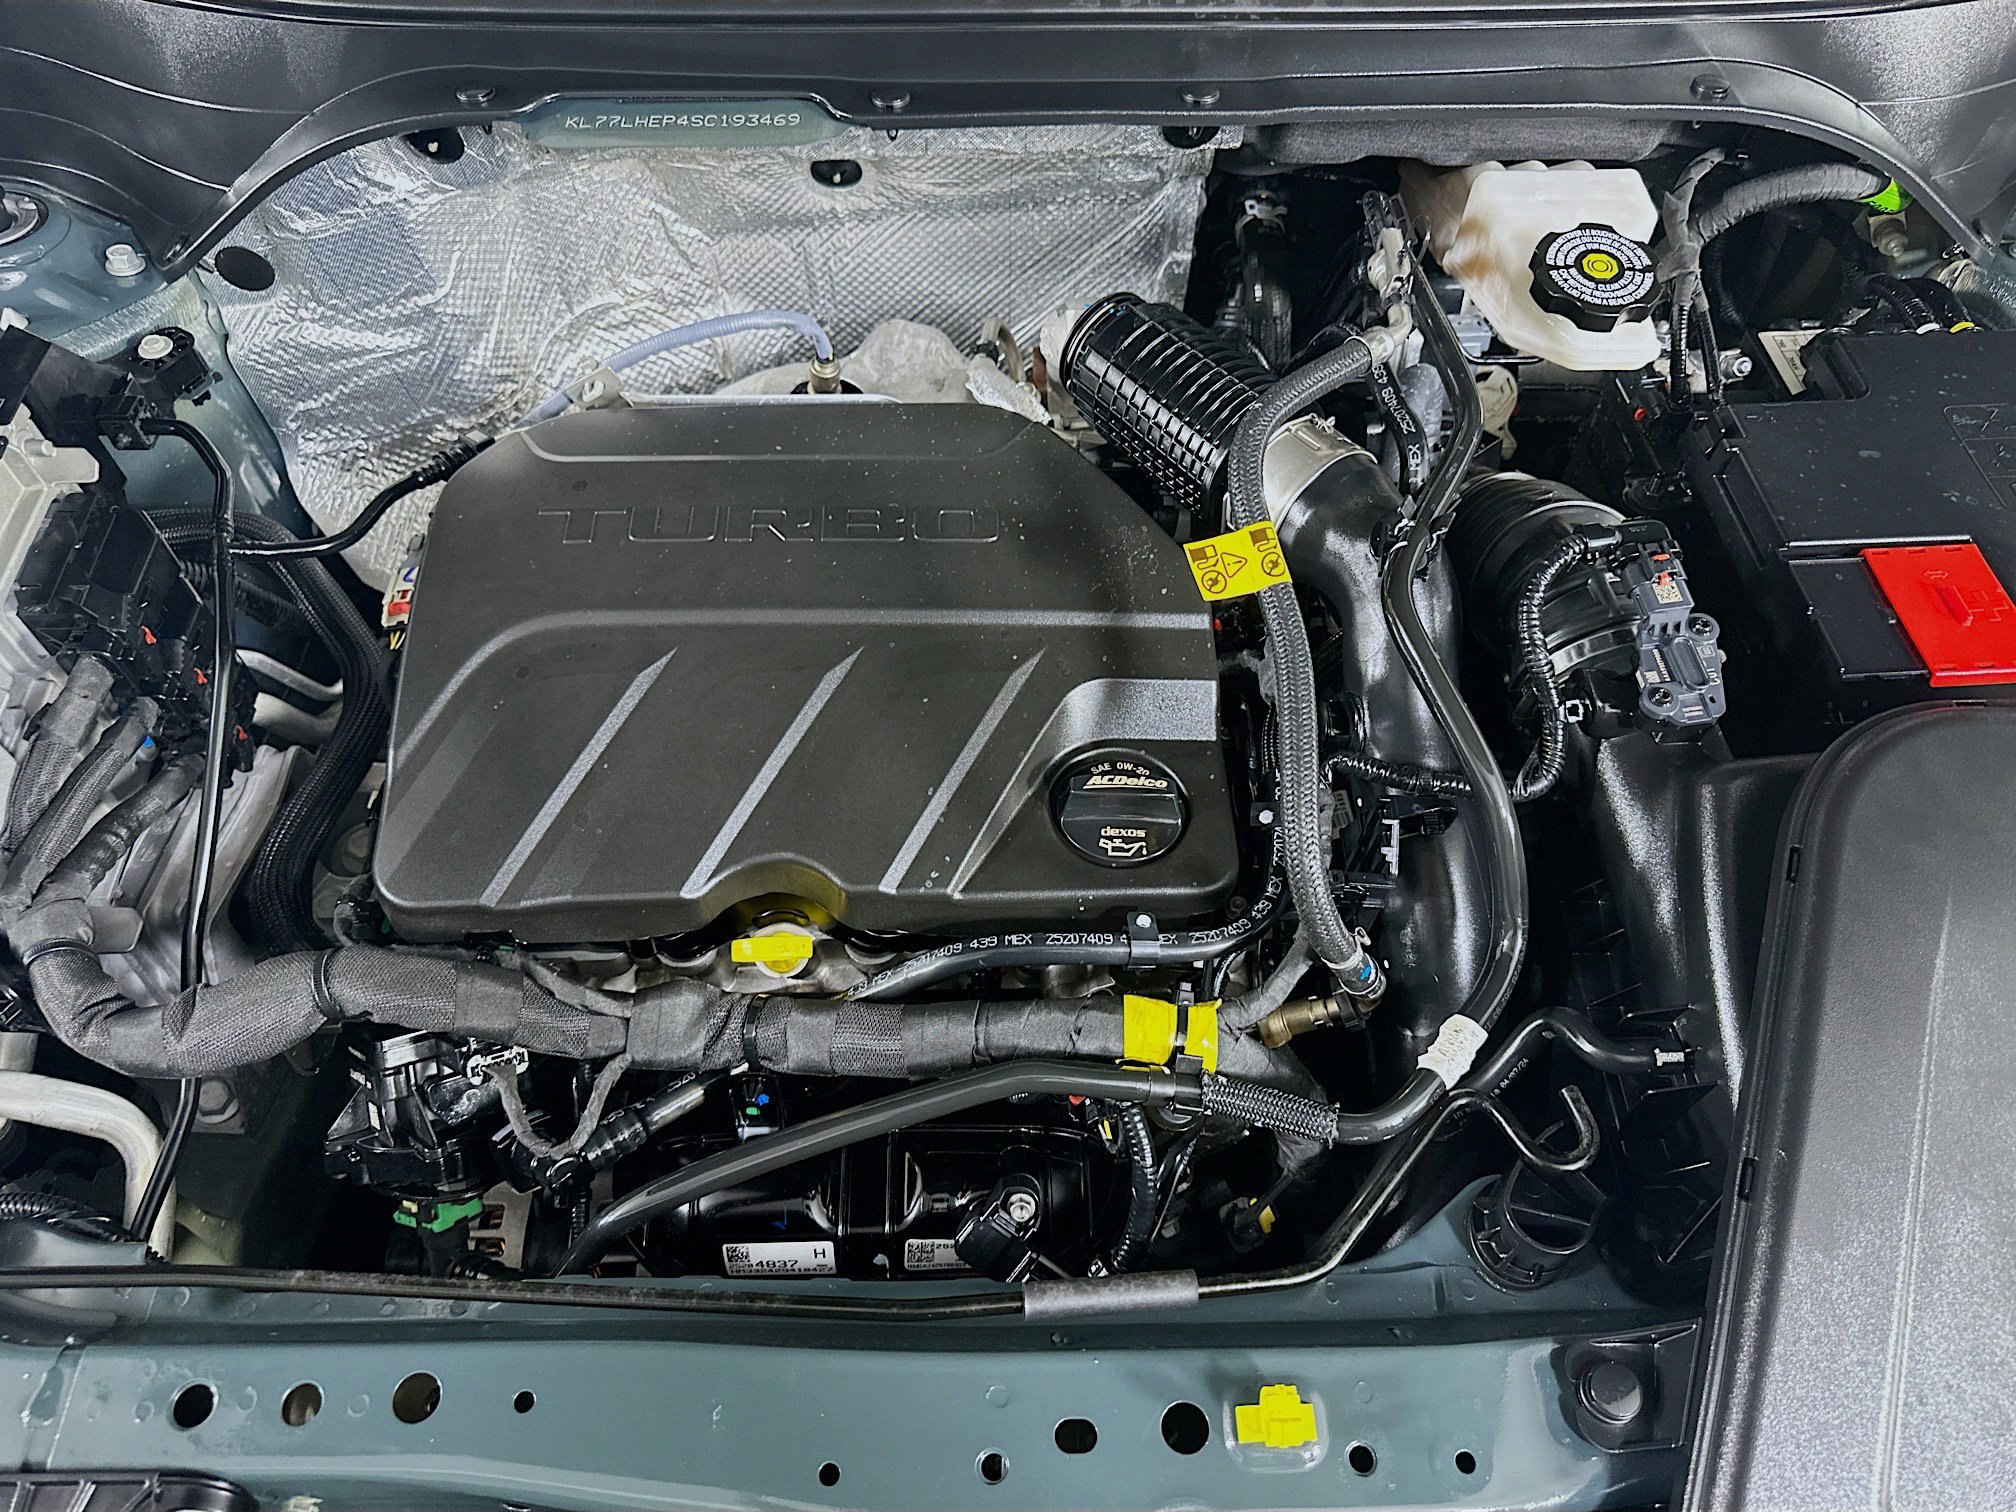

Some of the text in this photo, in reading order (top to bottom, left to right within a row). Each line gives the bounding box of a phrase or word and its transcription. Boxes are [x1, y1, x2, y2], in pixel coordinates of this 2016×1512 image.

[565, 113, 801, 129] KL77LHEP4SC193469
[1382, 387, 1416, 434] 25207409
[538, 505, 1000, 543] TURBO
[1090, 762, 1112, 775] SAE
[1083, 775, 1168, 788] ACDelco
[1100, 826, 1147, 838] dexos
[970, 935, 998, 950] 439
[1004, 933, 1032, 946] MEX
[1045, 933, 1114, 945] 25207409
[1158, 934, 1178, 945] EX
[813, 1248, 826, 1259] H
